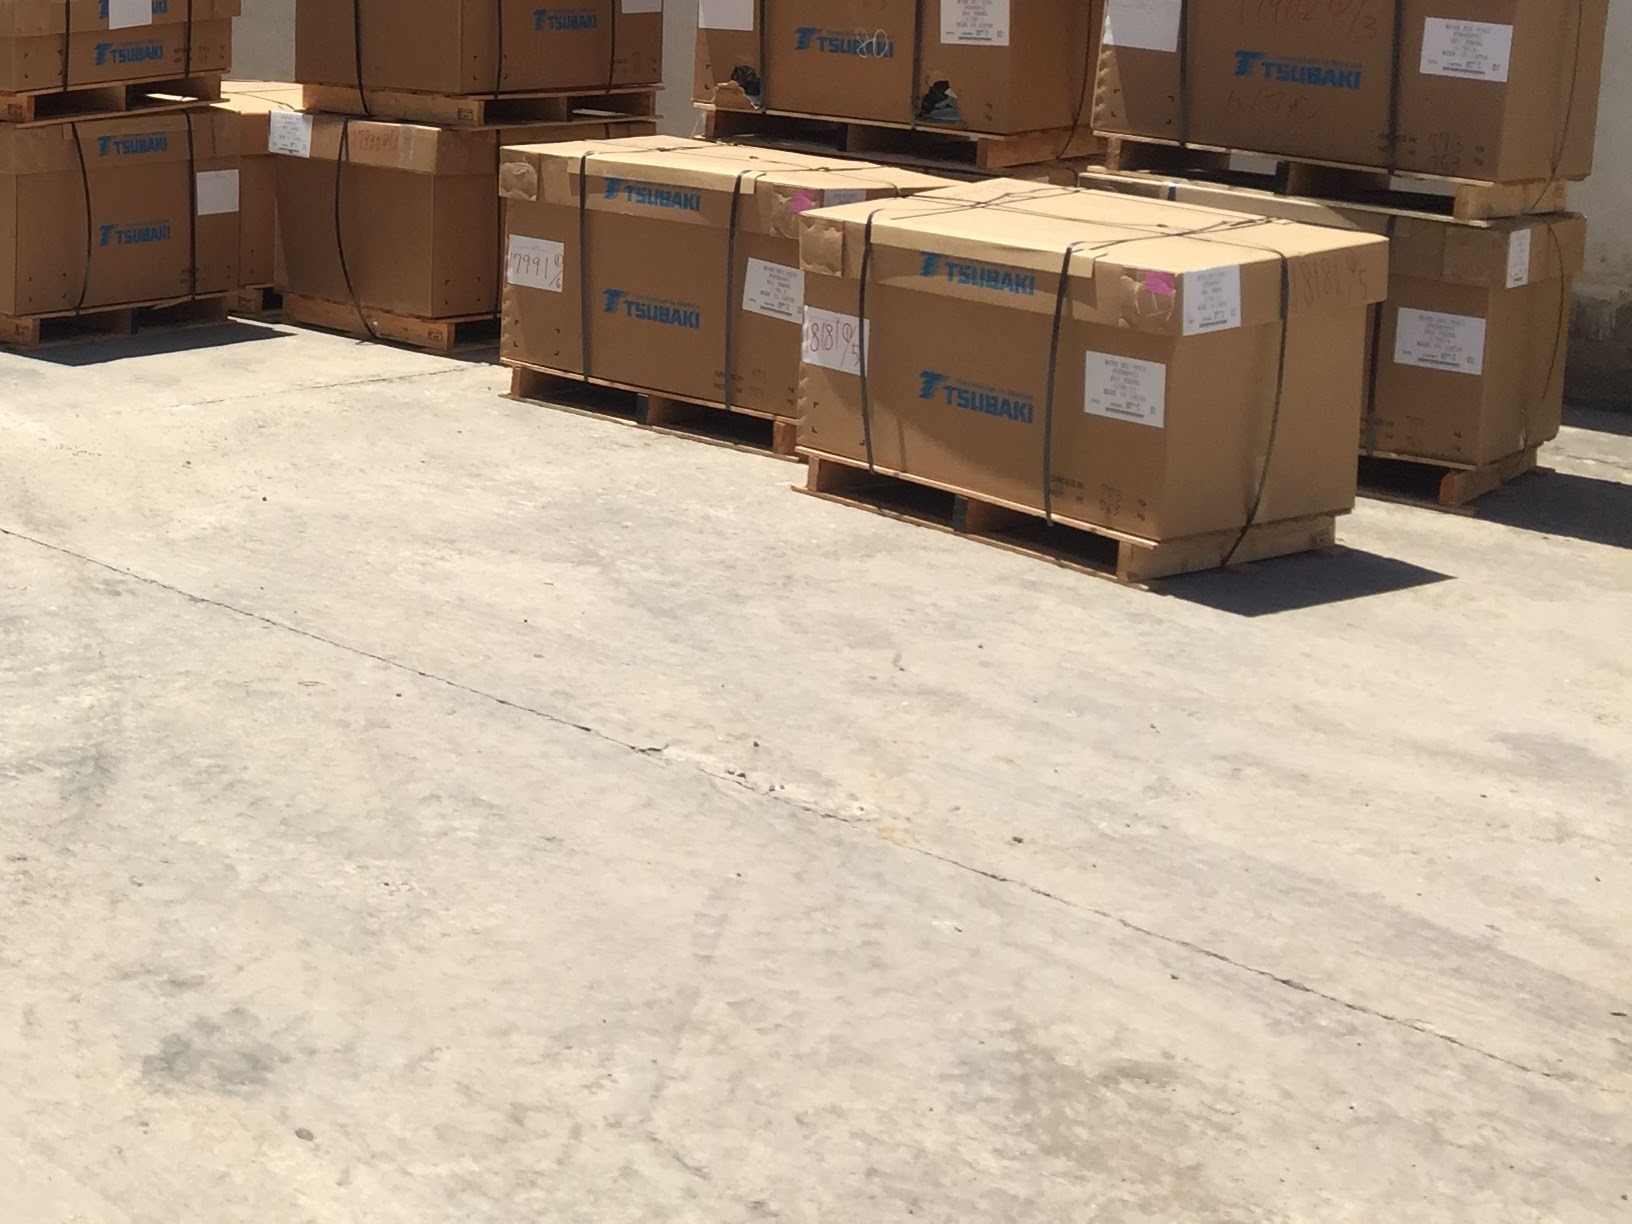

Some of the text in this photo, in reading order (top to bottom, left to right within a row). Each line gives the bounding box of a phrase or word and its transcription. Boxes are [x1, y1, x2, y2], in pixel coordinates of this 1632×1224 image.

[547, 14, 597, 30] TSUBAKI
[111, 45, 164, 64] TSUBAKI
[1262, 62, 1362, 91] TSUBAKI
[113, 136, 168, 155] TSUBAKI
[624, 184, 701, 212] TSUBAKI
[115, 225, 171, 245] TSUBAKI
[944, 262, 1037, 296] TSUBAKI
[624, 299, 700, 329] TSUBAKI
[943, 385, 1035, 425] TSUBAKI
